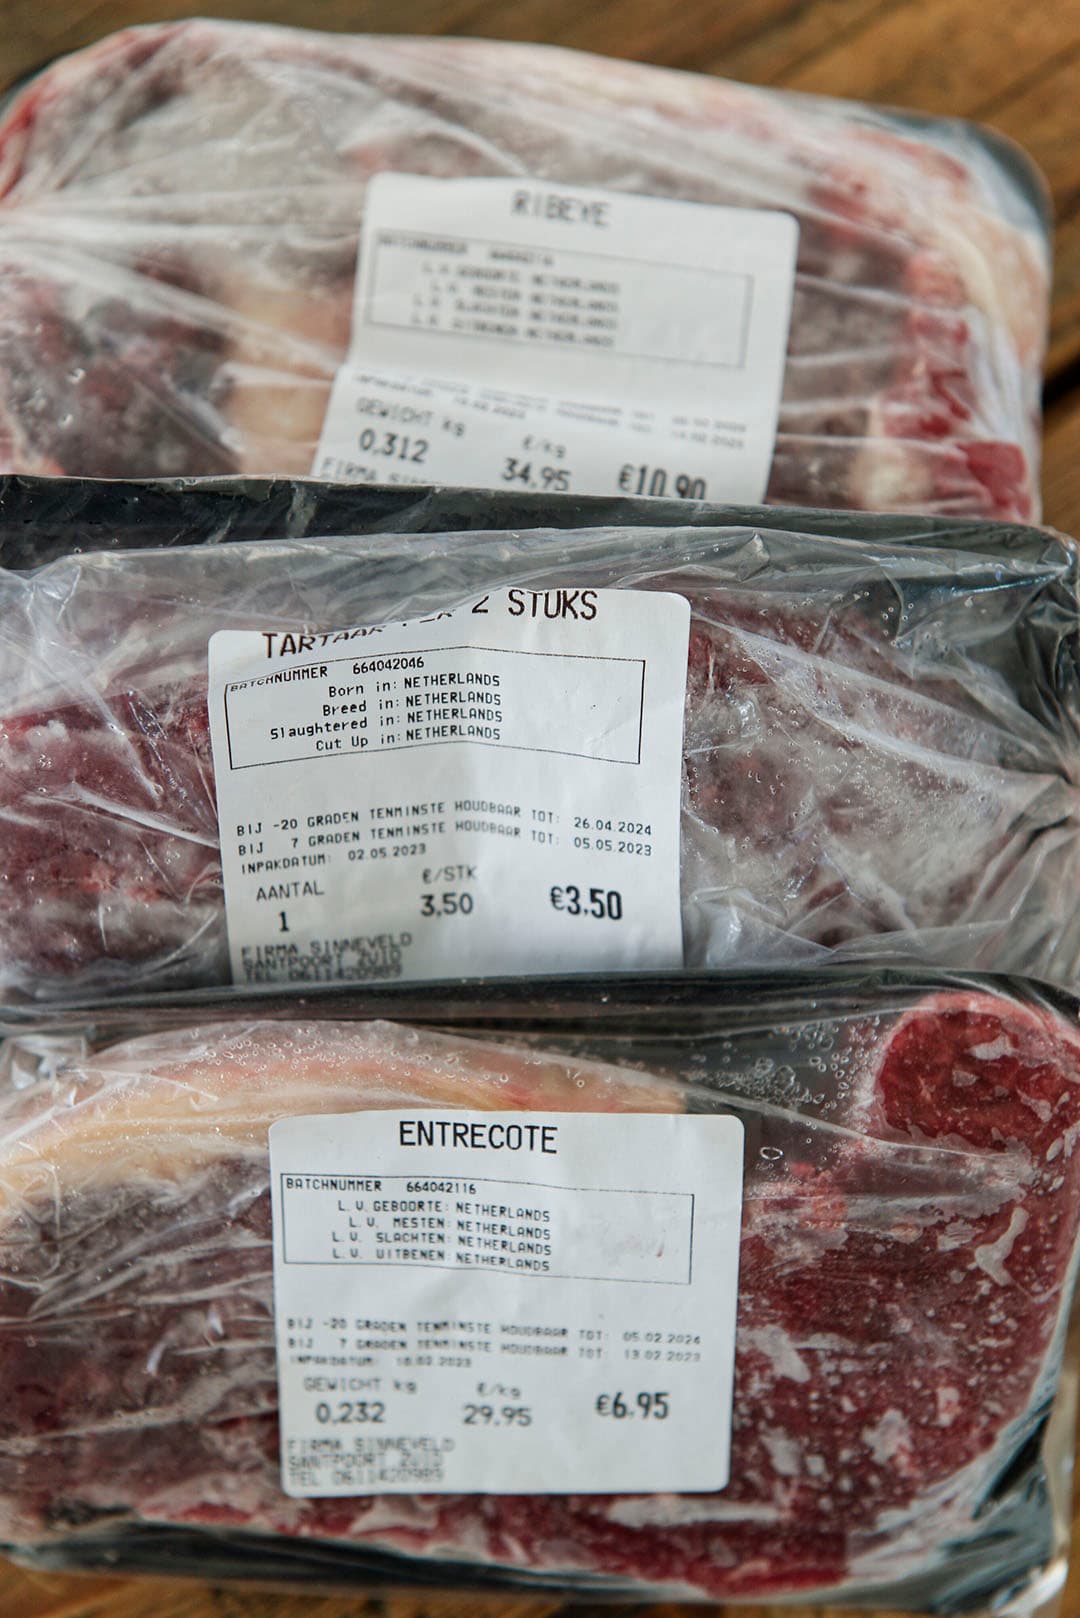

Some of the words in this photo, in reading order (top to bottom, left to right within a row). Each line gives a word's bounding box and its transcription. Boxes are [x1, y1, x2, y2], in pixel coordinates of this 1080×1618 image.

[512, 190, 609, 227] RIBEYE
[508, 589, 598, 620] STUKS
[230, 666, 328, 692] BATCHNUMMER
[353, 656, 425, 675] 664042046
[329, 684, 364, 698] Born
[404, 672, 500, 689] NETHERLANDS
[323, 700, 367, 716] Breed
[406, 691, 501, 708] NETHERLANDS
[270, 717, 368, 740] Slaughtered
[408, 708, 502, 724] NETHERLANDS
[316, 739, 342, 751] Cut
[351, 735, 369, 748] Up
[406, 725, 501, 741] NETHERLANDS
[237, 822, 262, 836] BIJ
[273, 819, 298, 831] -20
[307, 811, 359, 828] GRADEN
[370, 802, 445, 821] TENMINSTE
[455, 800, 521, 818] HOUDBAAR
[574, 817, 652, 836] 26.04.2024
[238, 842, 264, 856] BIJ
[291, 838, 299, 849] 7
[308, 832, 360, 847] GRADEN
[371, 822, 446, 840] TENMINSTE
[456, 820, 521, 838] HOUDBAAR
[574, 837, 652, 857] 05.05.2023
[348, 843, 426, 861] 02.05.2023
[256, 880, 324, 902] AANTAL
[278, 911, 290, 932] 1
[400, 1121, 558, 1154] ENTRECOTE
[286, 1178, 382, 1192] BATCHNUMMER
[406, 1182, 477, 1195] 664042116
[456, 1201, 551, 1222] NETHERLANDS
[457, 1220, 551, 1241] NETHERLANDS
[458, 1236, 552, 1256] NETHERLANDS
[456, 1252, 550, 1272] NETHERLANDS
